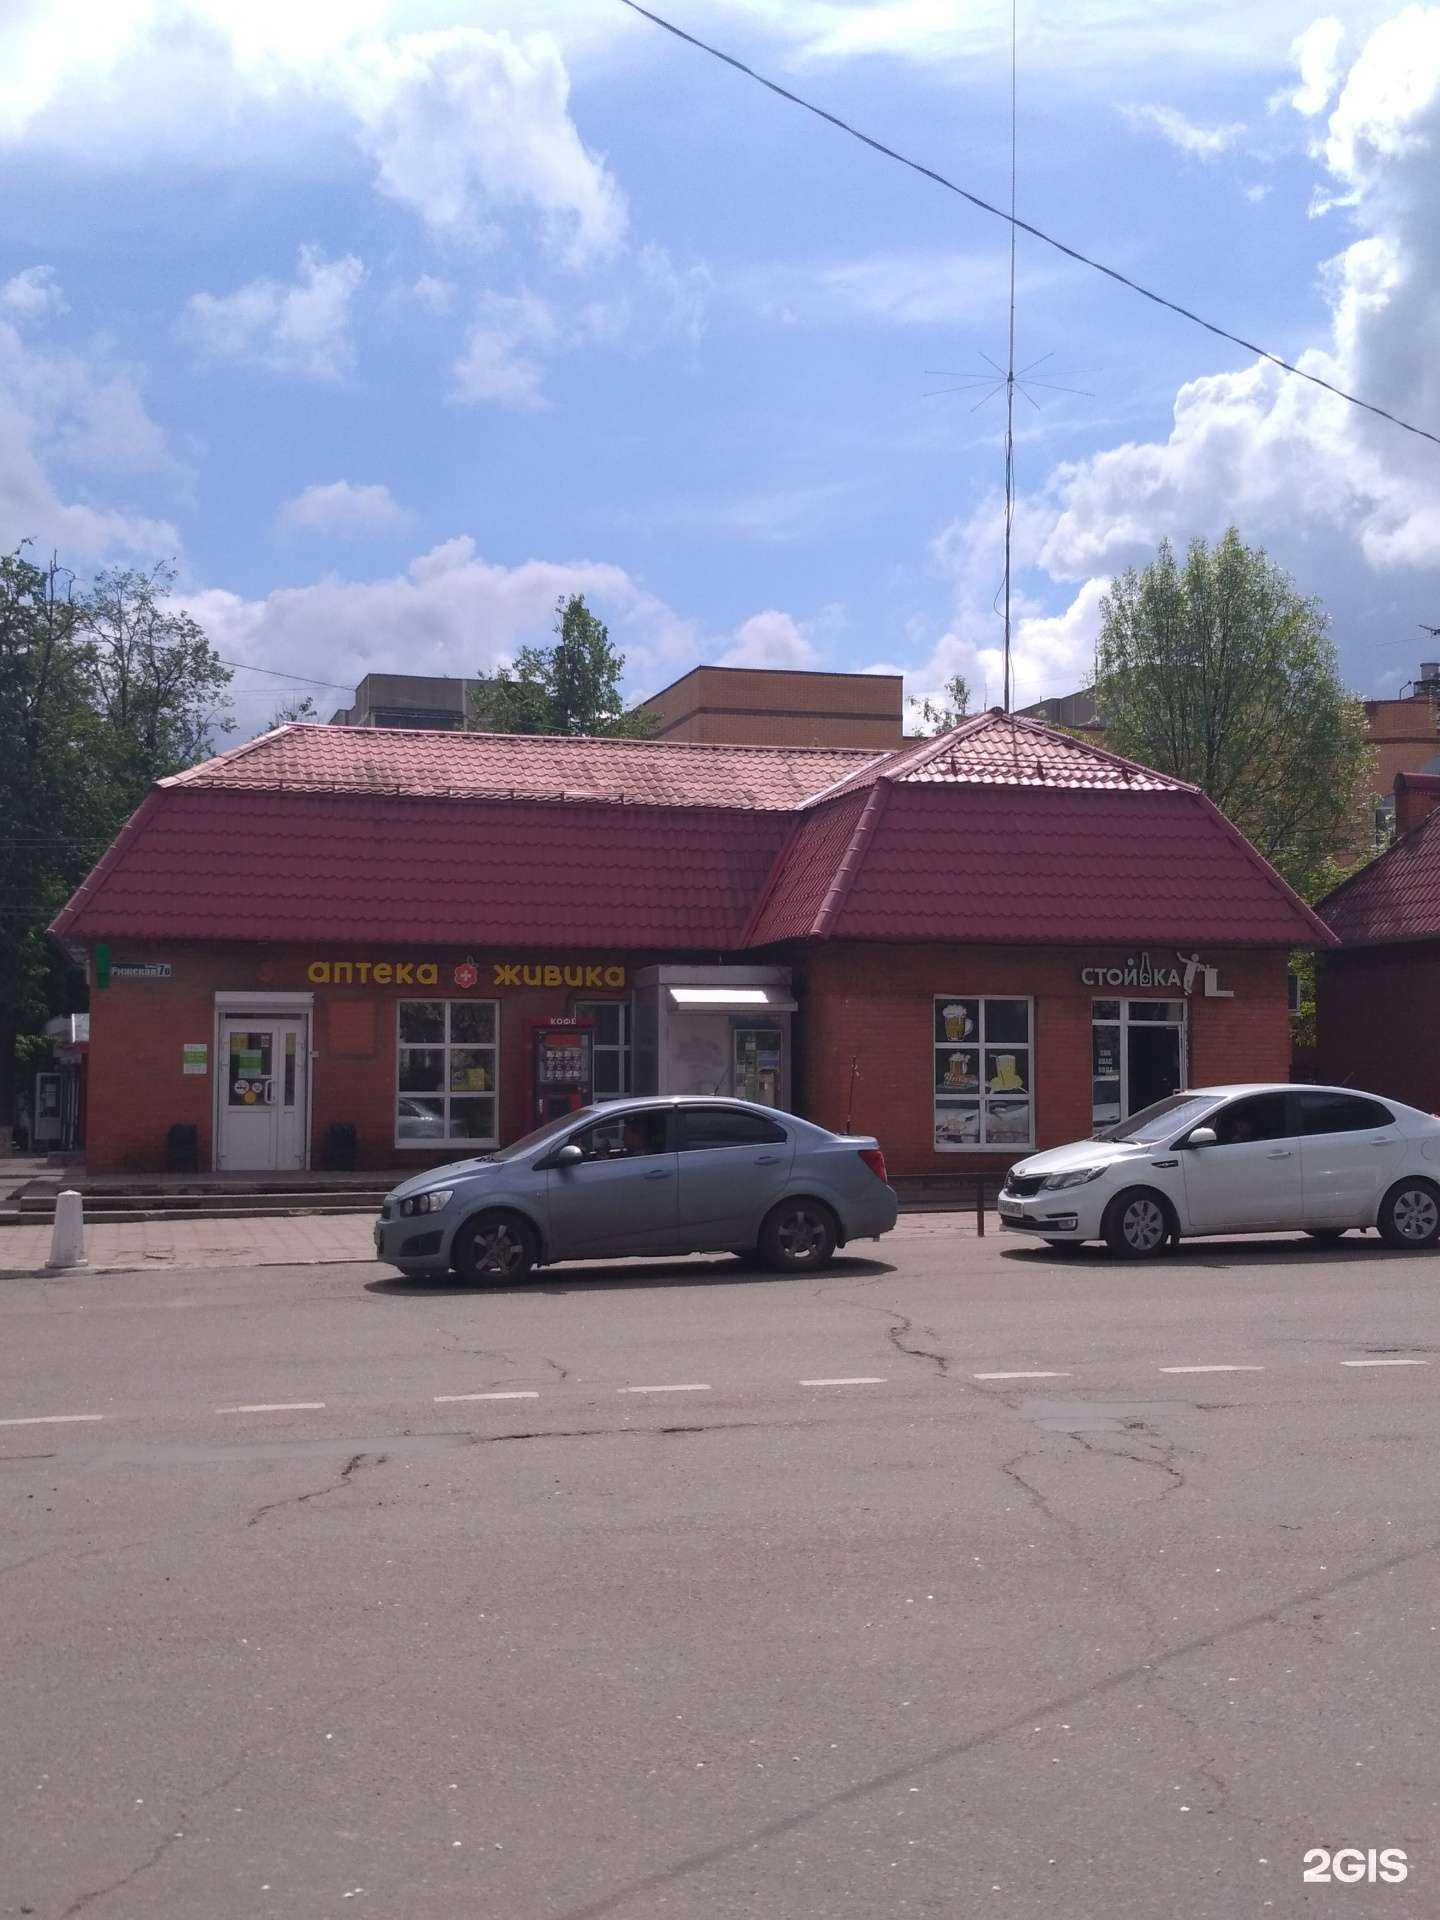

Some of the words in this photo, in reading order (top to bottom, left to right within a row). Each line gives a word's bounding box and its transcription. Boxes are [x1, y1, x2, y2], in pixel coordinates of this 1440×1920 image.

[307, 961, 439, 985] аптека
[494, 963, 626, 987] живика
[550, 1017, 577, 1025] КОФЕ
